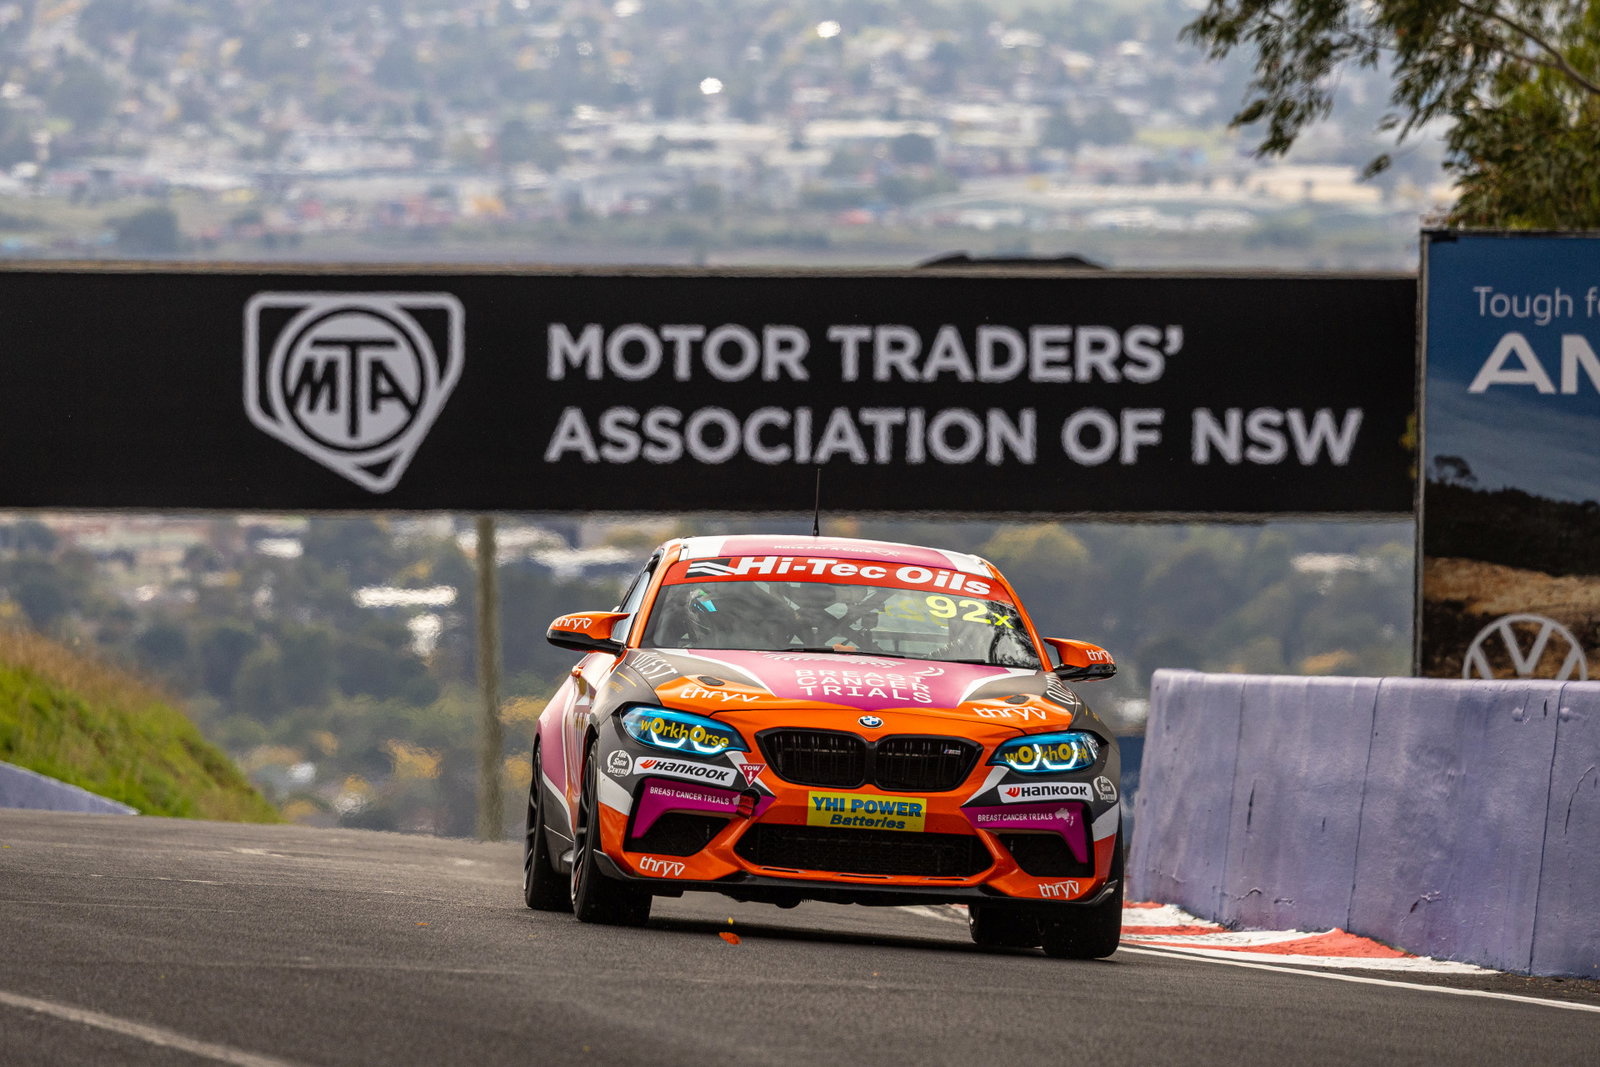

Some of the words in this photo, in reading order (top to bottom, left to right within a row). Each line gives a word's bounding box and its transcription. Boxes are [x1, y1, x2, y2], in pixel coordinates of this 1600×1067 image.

[1473, 286, 1573, 326] Tough
[1584, 286, 1600, 317] f
[547, 323, 810, 382] MOTOR
[289, 337, 417, 438] MTA
[545, 406, 1036, 465] ASSOCIATION
[1062, 407, 1164, 466] OF
[1191, 407, 1363, 466] NSW
[734, 555, 887, 579] Hi-Tec
[895, 566, 991, 596] Oils
[555, 617, 592, 630] thryv
[794, 669, 926, 683] BREAST
[797, 676, 930, 694] CANCER
[680, 685, 760, 703] thryv
[800, 685, 933, 704] TRIALS
[973, 706, 1046, 720] thryv
[743, 764, 760, 772] TOW
[649, 786, 676, 797] BREAST
[676, 790, 702, 801] CANCER
[703, 794, 730, 806] TRIALS
[812, 797, 845, 812] YHI
[851, 799, 922, 818] POWER
[830, 814, 906, 830] Batteries
[977, 813, 1002, 822] BREAST
[1002, 813, 1028, 822] CANCER
[1028, 812, 1054, 821] TRIALS
[639, 856, 686, 877] thryv
[1038, 880, 1080, 898] thryv
